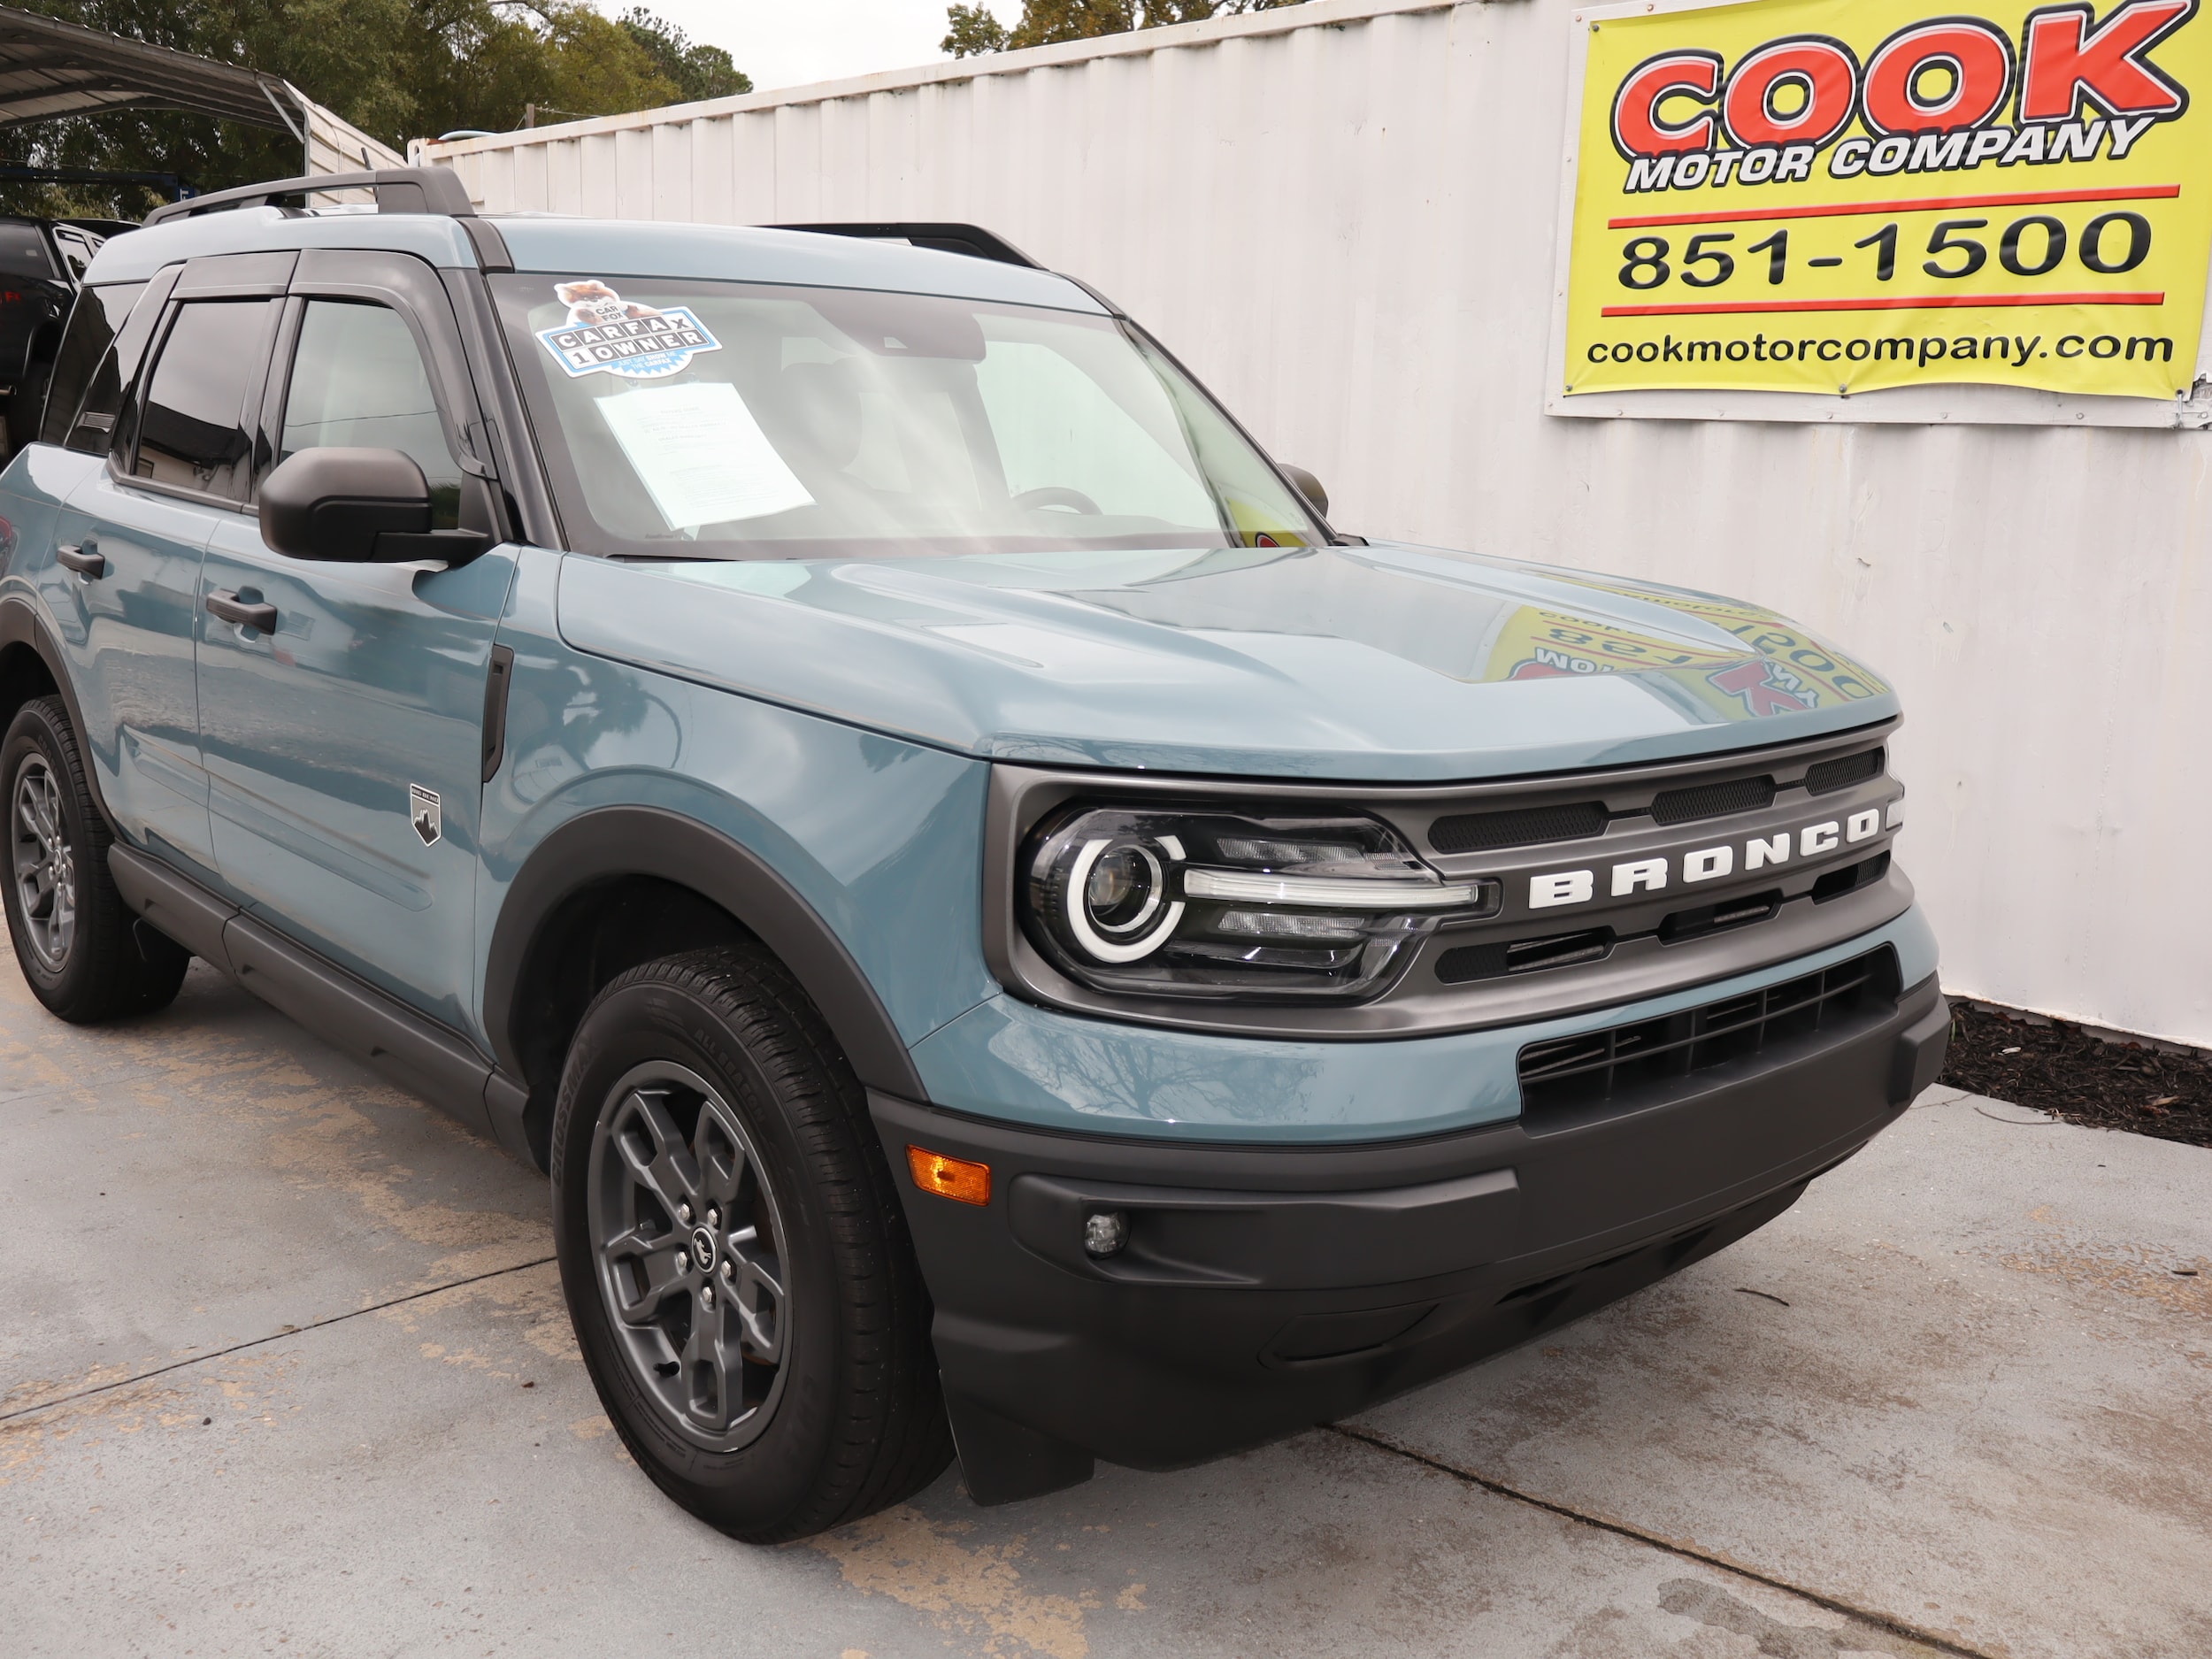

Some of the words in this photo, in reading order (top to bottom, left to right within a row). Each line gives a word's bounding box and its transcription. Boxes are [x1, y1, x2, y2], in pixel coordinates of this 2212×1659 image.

[1611, 0, 2196, 159] COOK
[1625, 145, 1813, 193] MOTOR
[1831, 117, 2156, 178] COMPANY
[1617, 211, 2152, 289] 851-1500
[595, 305, 618, 315] CAR
[602, 311, 623, 321] FOX
[558, 316, 688, 348] CARFAX
[572, 350, 589, 365] 1
[595, 332, 703, 359] OWNER
[1587, 331, 2174, 368] cookmotorcompany.com
[1528, 809, 1880, 909] BRONCO
